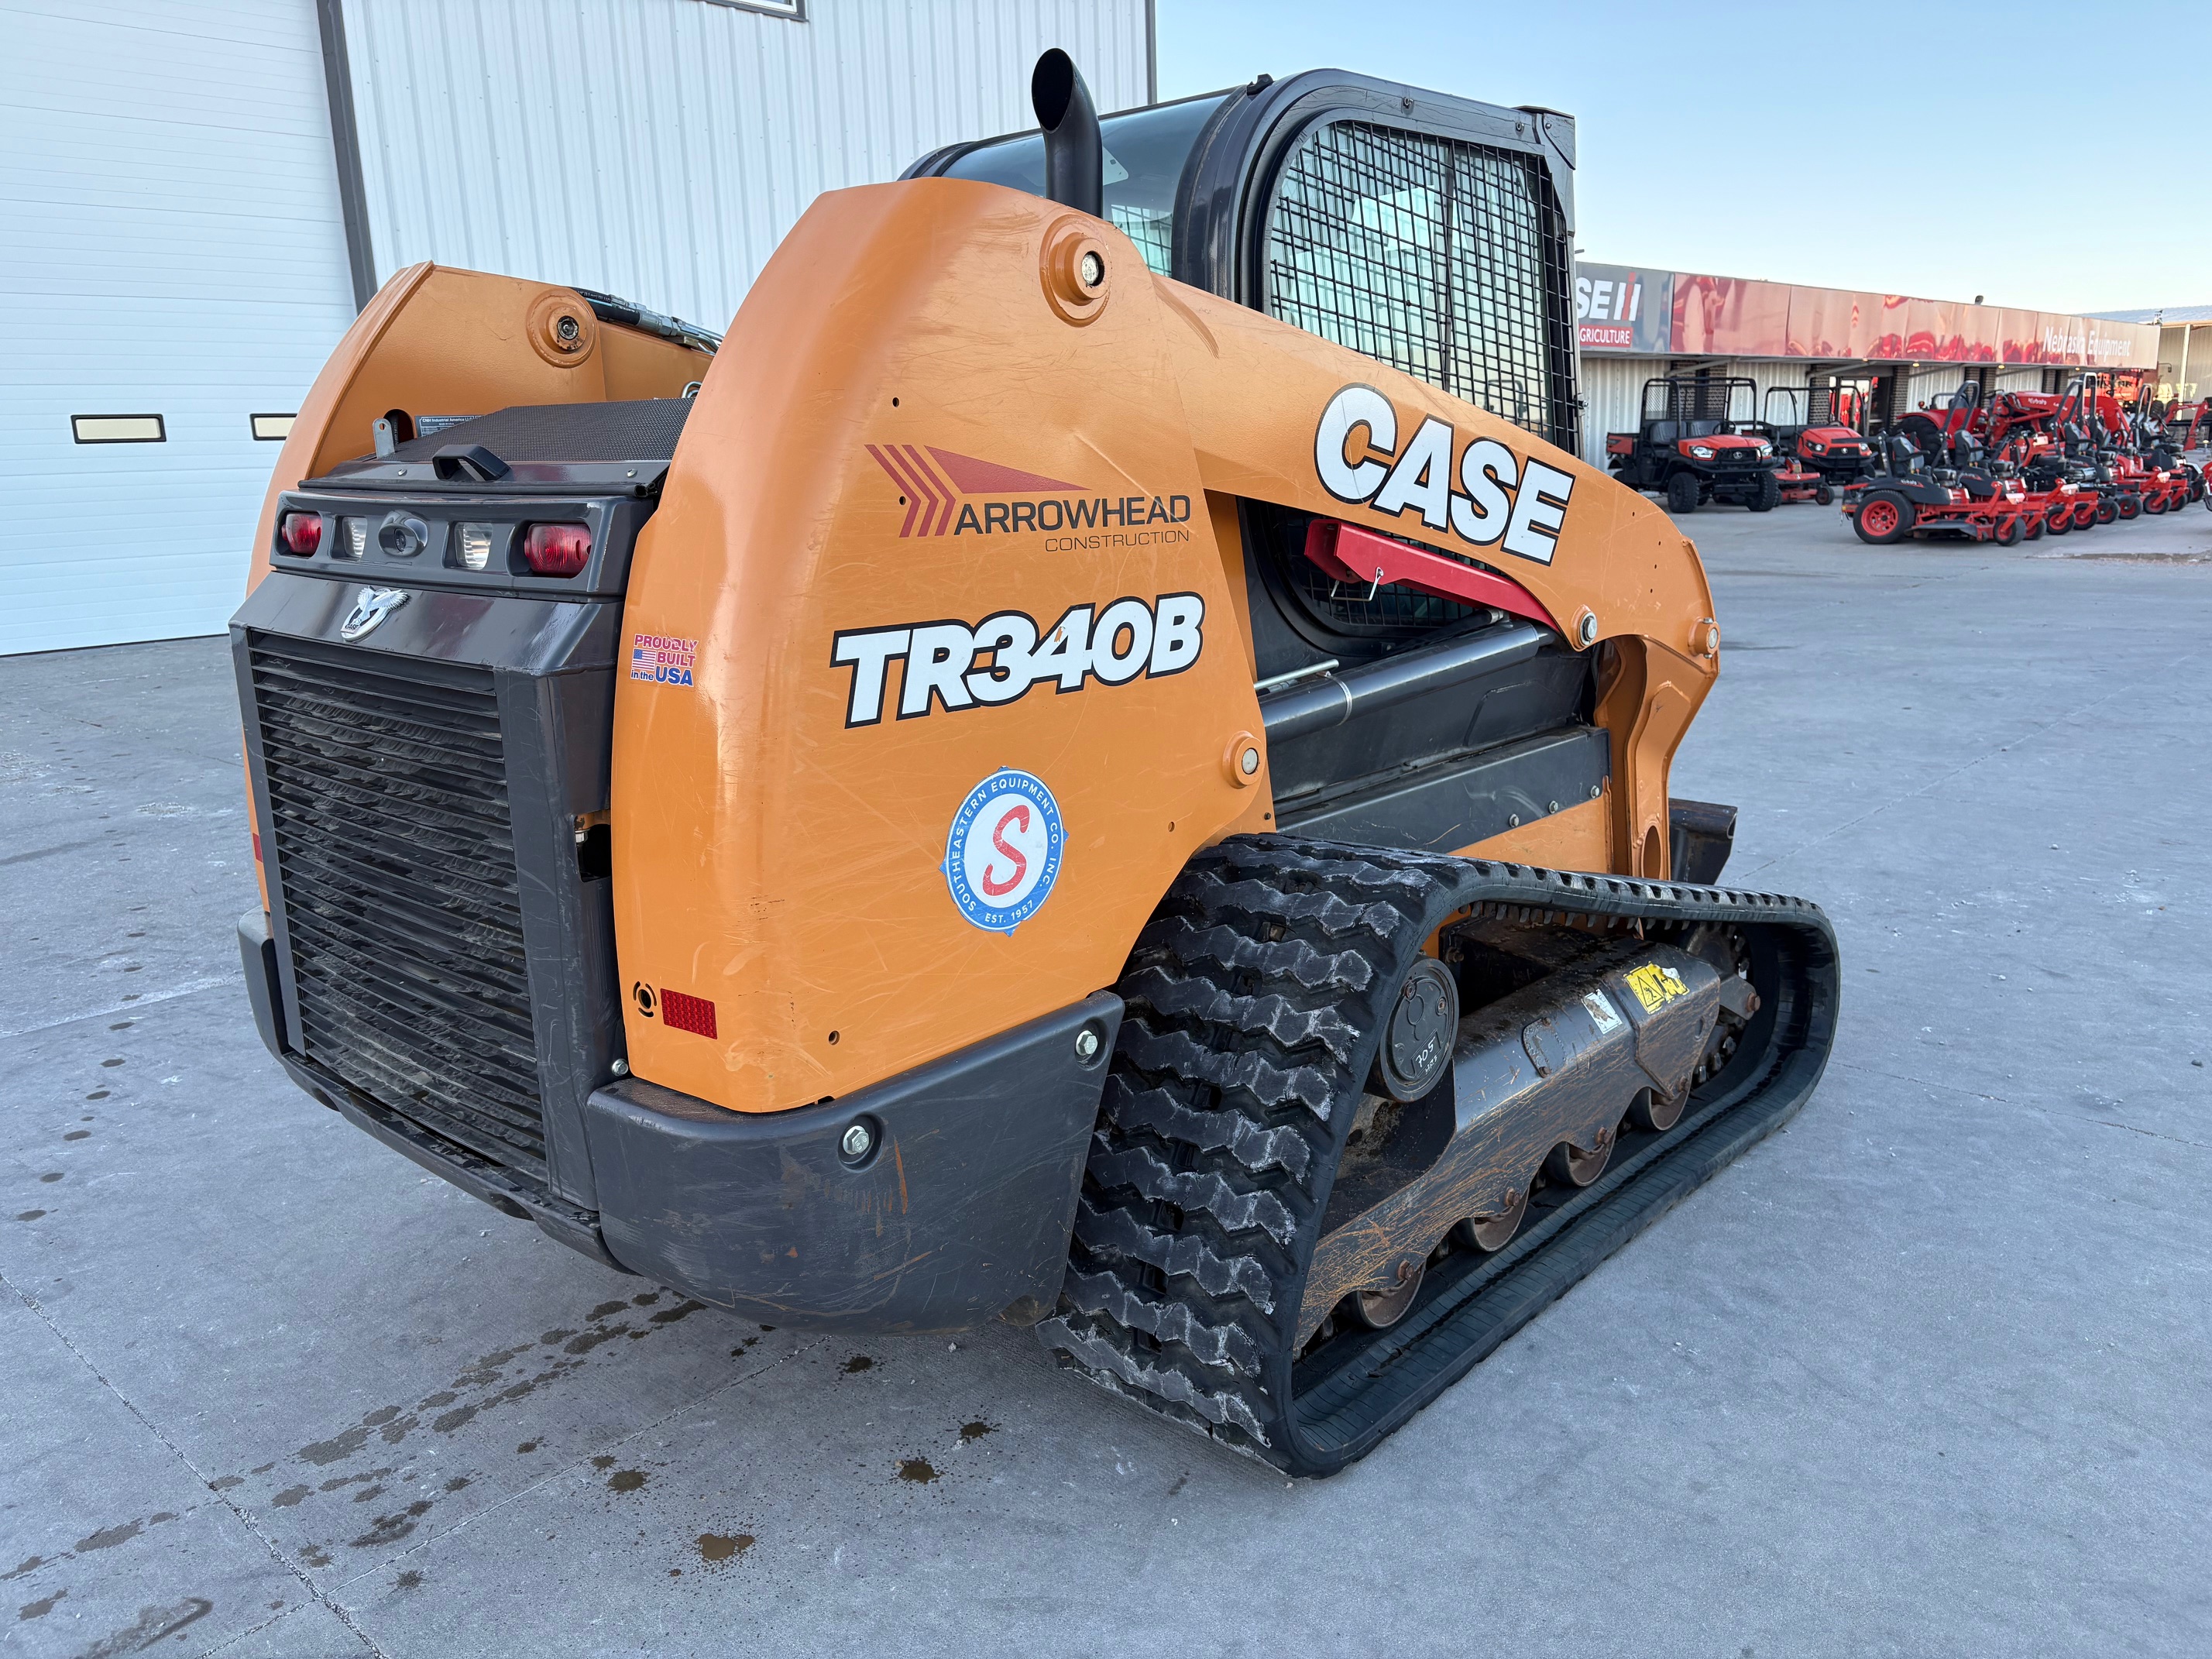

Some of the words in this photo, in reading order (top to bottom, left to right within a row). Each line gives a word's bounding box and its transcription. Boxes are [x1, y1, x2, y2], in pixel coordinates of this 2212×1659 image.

[1575, 276, 1613, 320] SE
[1578, 327, 1630, 345] GRICULTURE
[2042, 325, 2086, 356] Nebraska
[2087, 330, 2131, 363] Equipment
[1314, 383, 1576, 567] CASE
[953, 494, 1191, 536] ARROWHEAD
[1045, 530, 1190, 552] CONSTRUCTION
[634, 634, 698, 652] PROUDLY
[657, 651, 696, 667] BUILT
[631, 670, 639, 678] in
[640, 672, 654, 681] the
[655, 666, 694, 686] USA
[830, 592, 1206, 730] TR340B
[991, 778, 1054, 816] EQUIPMENT
[952, 789, 988, 912] SOUTHEASTERN
[982, 804, 1030, 896] S
[1049, 823, 1059, 850] CO.
[1039, 857, 1058, 888] INC.
[984, 912, 1007, 923] EST.
[1011, 899, 1034, 921] 1957
[1416, 1036, 1436, 1068] 705
